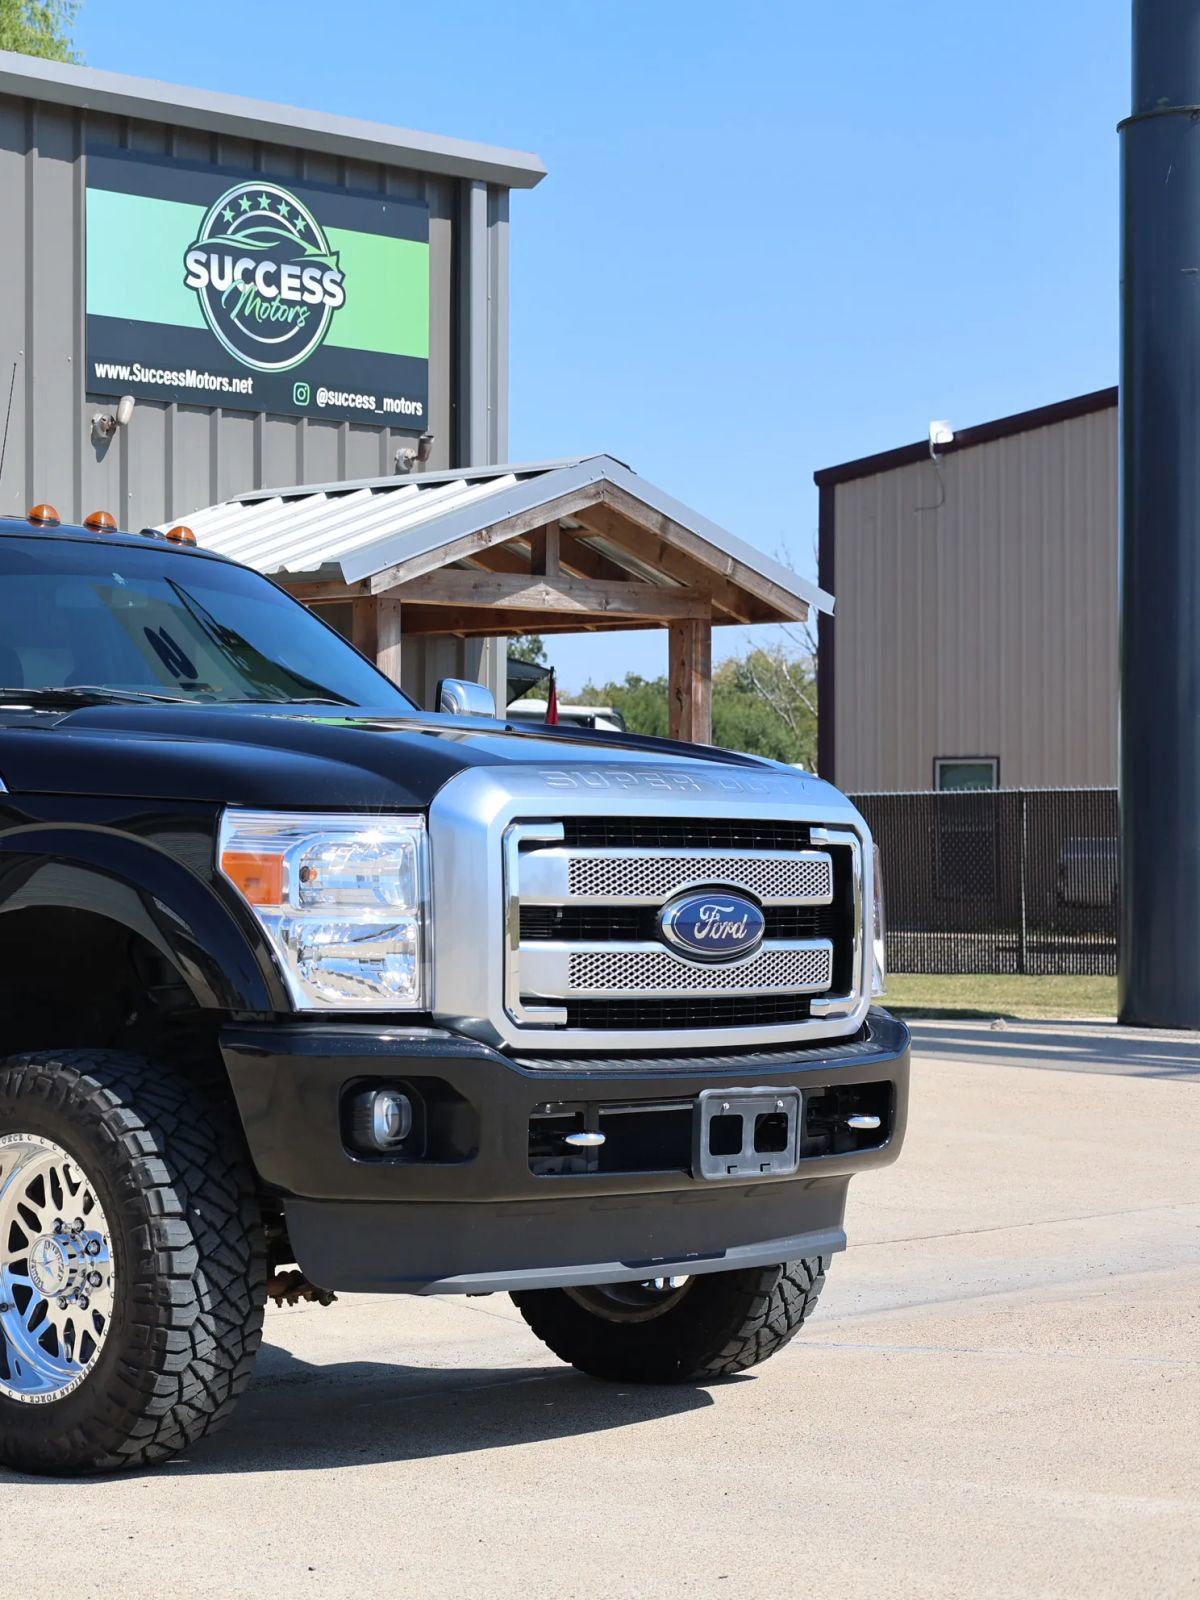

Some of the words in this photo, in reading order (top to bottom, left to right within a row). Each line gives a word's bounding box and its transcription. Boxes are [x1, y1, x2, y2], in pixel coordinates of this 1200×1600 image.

[185, 250, 345, 307] SUCCESS
[222, 279, 311, 328] Motors
[94, 362, 253, 394] www.SuccessMotors.net
[316, 387, 423, 416] @success_motors
[538, 771, 702, 792] SUPER
[693, 904, 748, 940] Ford
